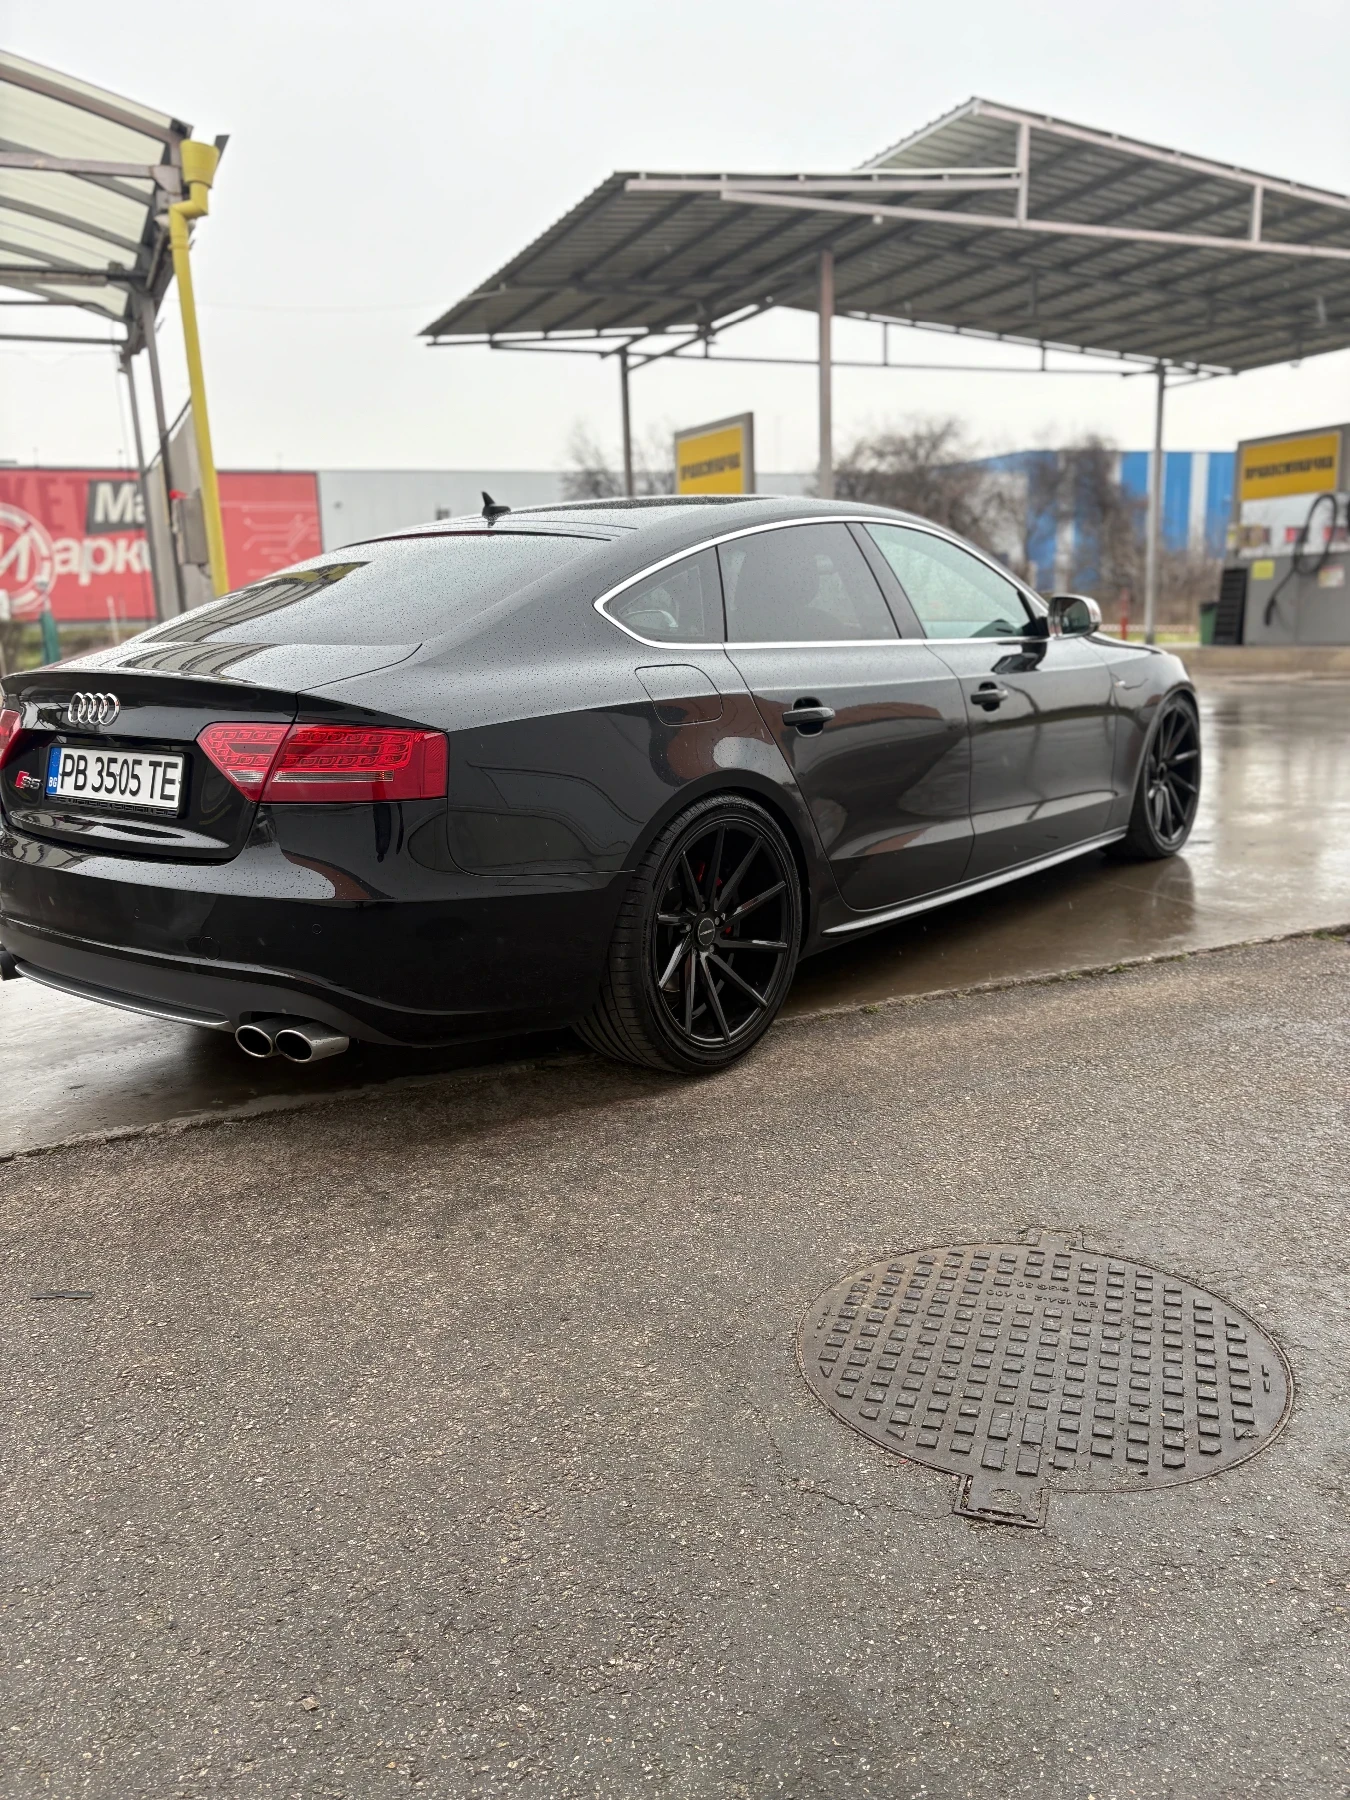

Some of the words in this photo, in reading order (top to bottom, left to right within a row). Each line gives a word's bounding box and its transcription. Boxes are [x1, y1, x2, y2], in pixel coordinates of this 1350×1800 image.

[48, 776, 58, 788] BG
[60, 753, 88, 791] PB
[91, 756, 142, 796] 3505
[148, 760, 178, 801] TE
[1078, 1300, 1098, 1308] EN
